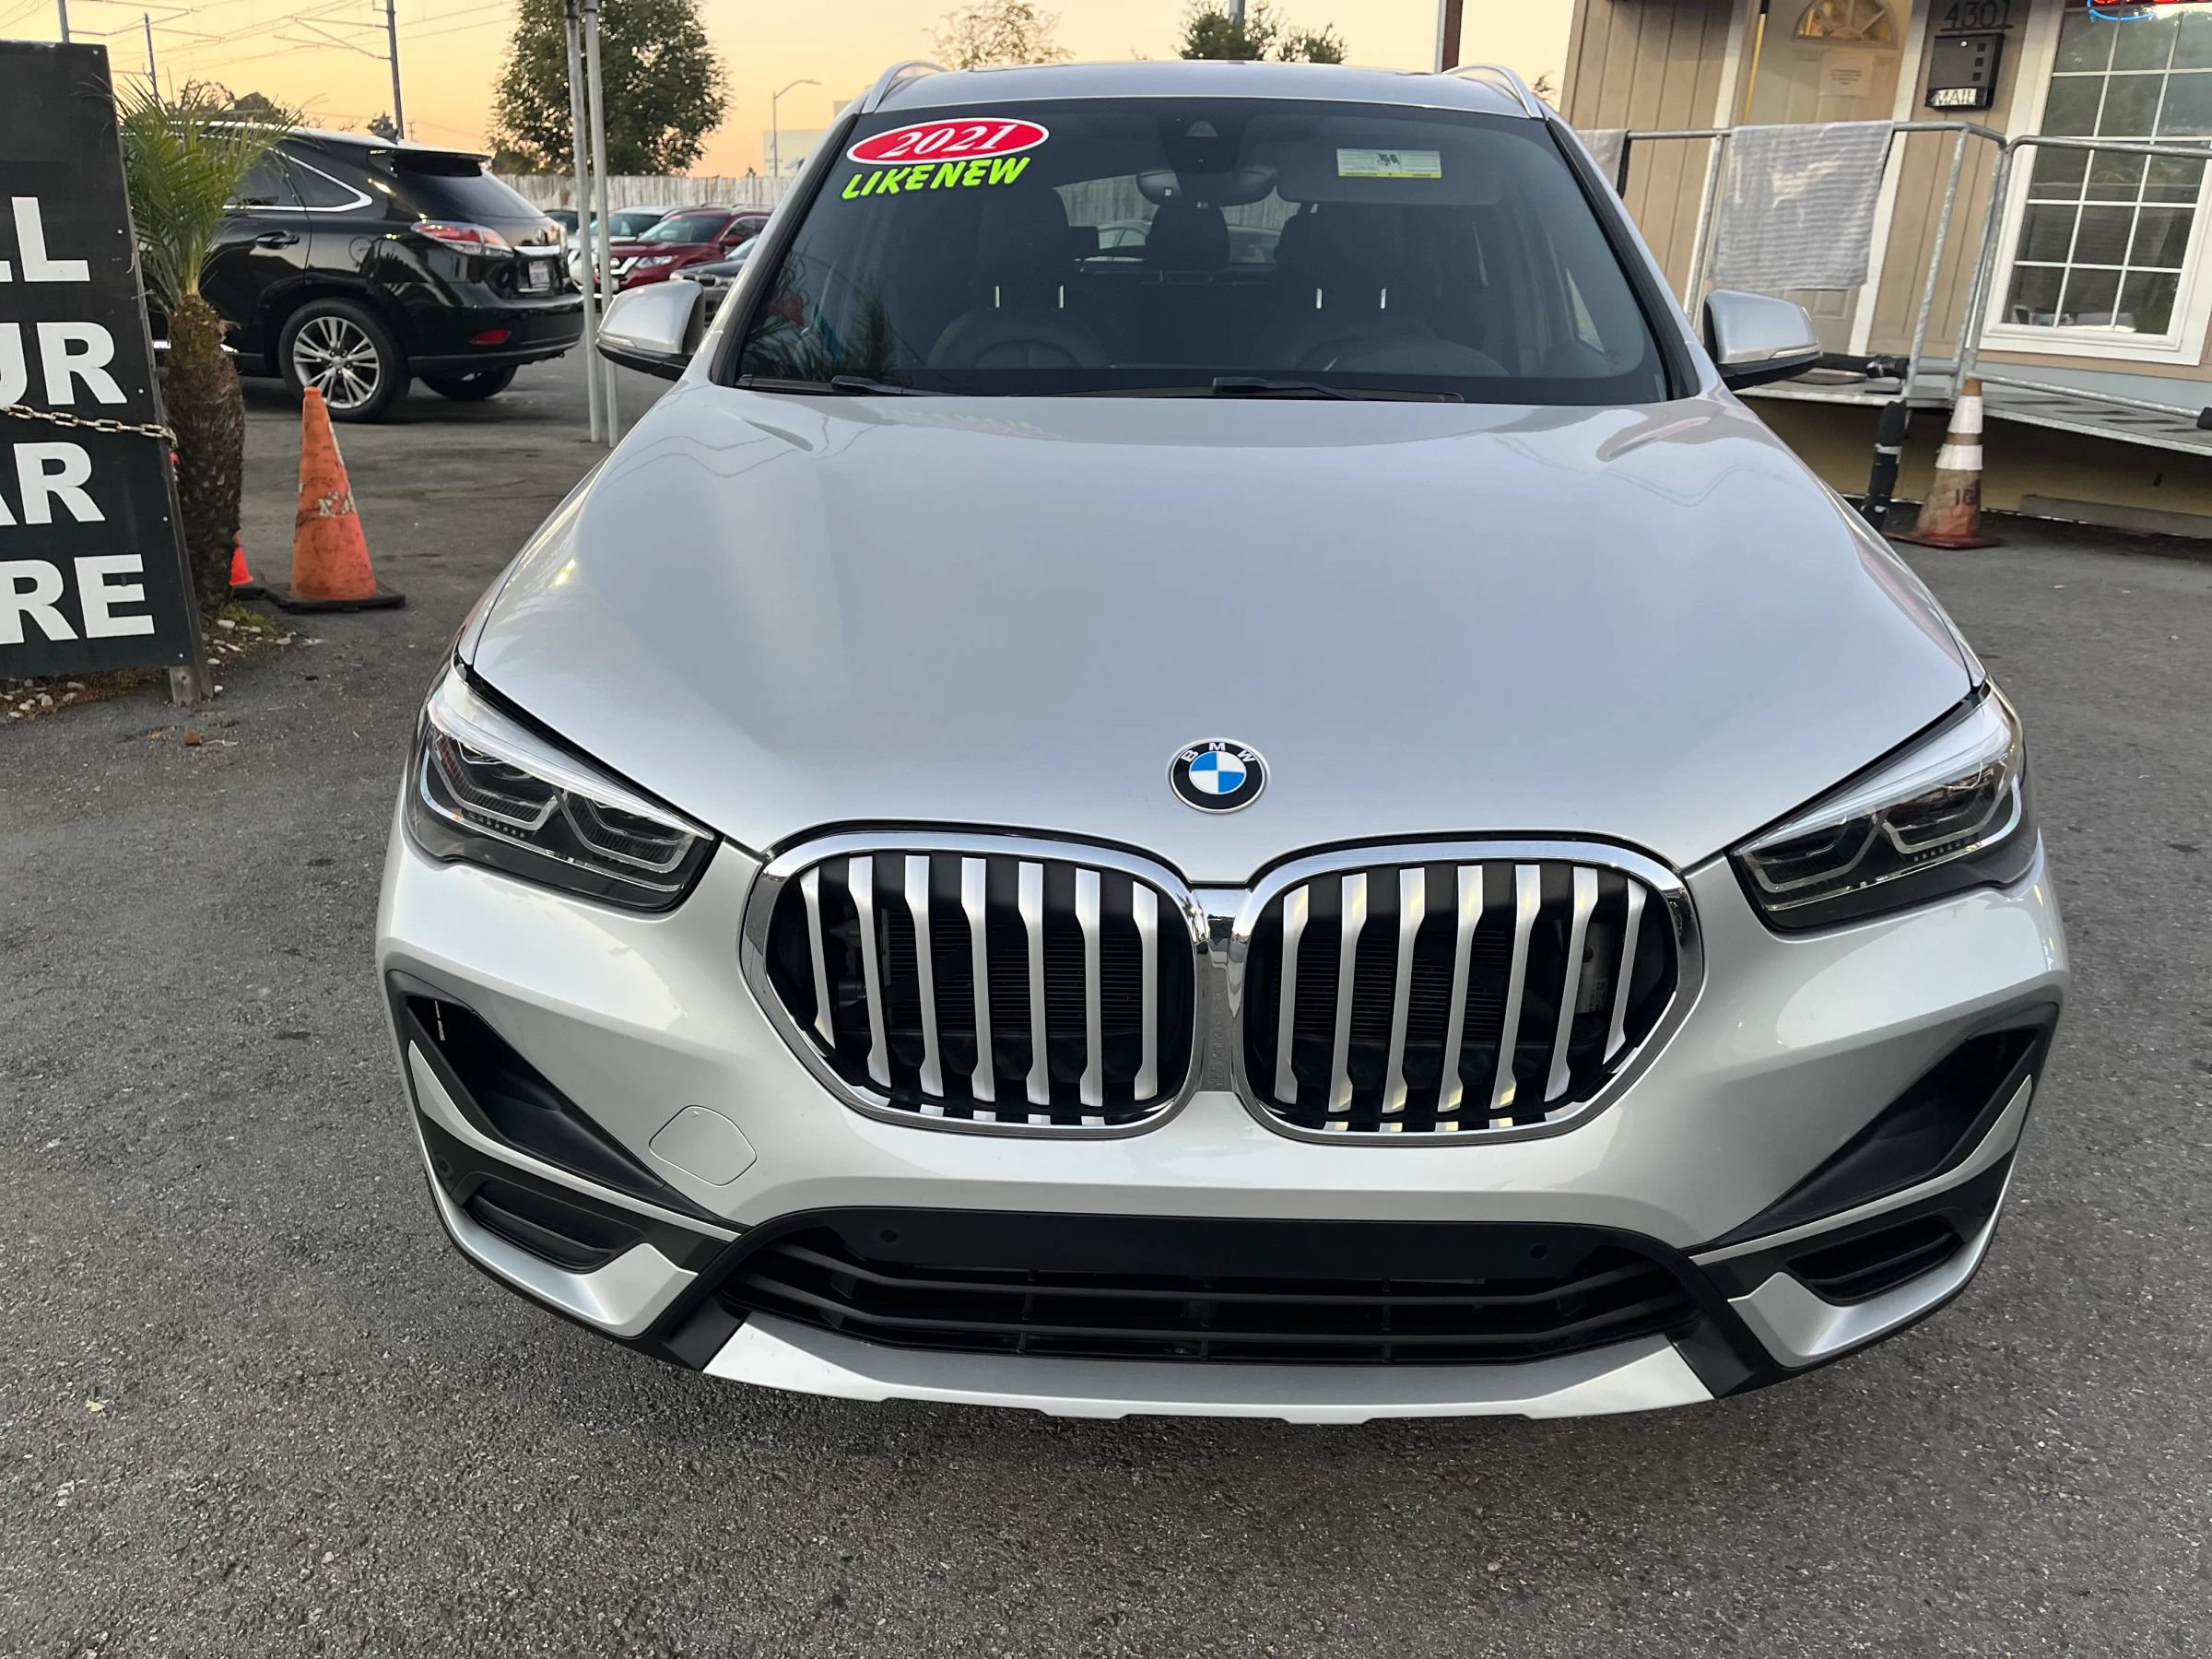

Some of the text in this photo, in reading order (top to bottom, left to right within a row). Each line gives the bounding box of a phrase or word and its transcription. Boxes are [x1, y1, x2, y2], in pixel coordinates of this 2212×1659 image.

[877, 124, 1018, 159] 2021
[0, 196, 90, 282] L
[1180, 742, 1256, 762] BMW
